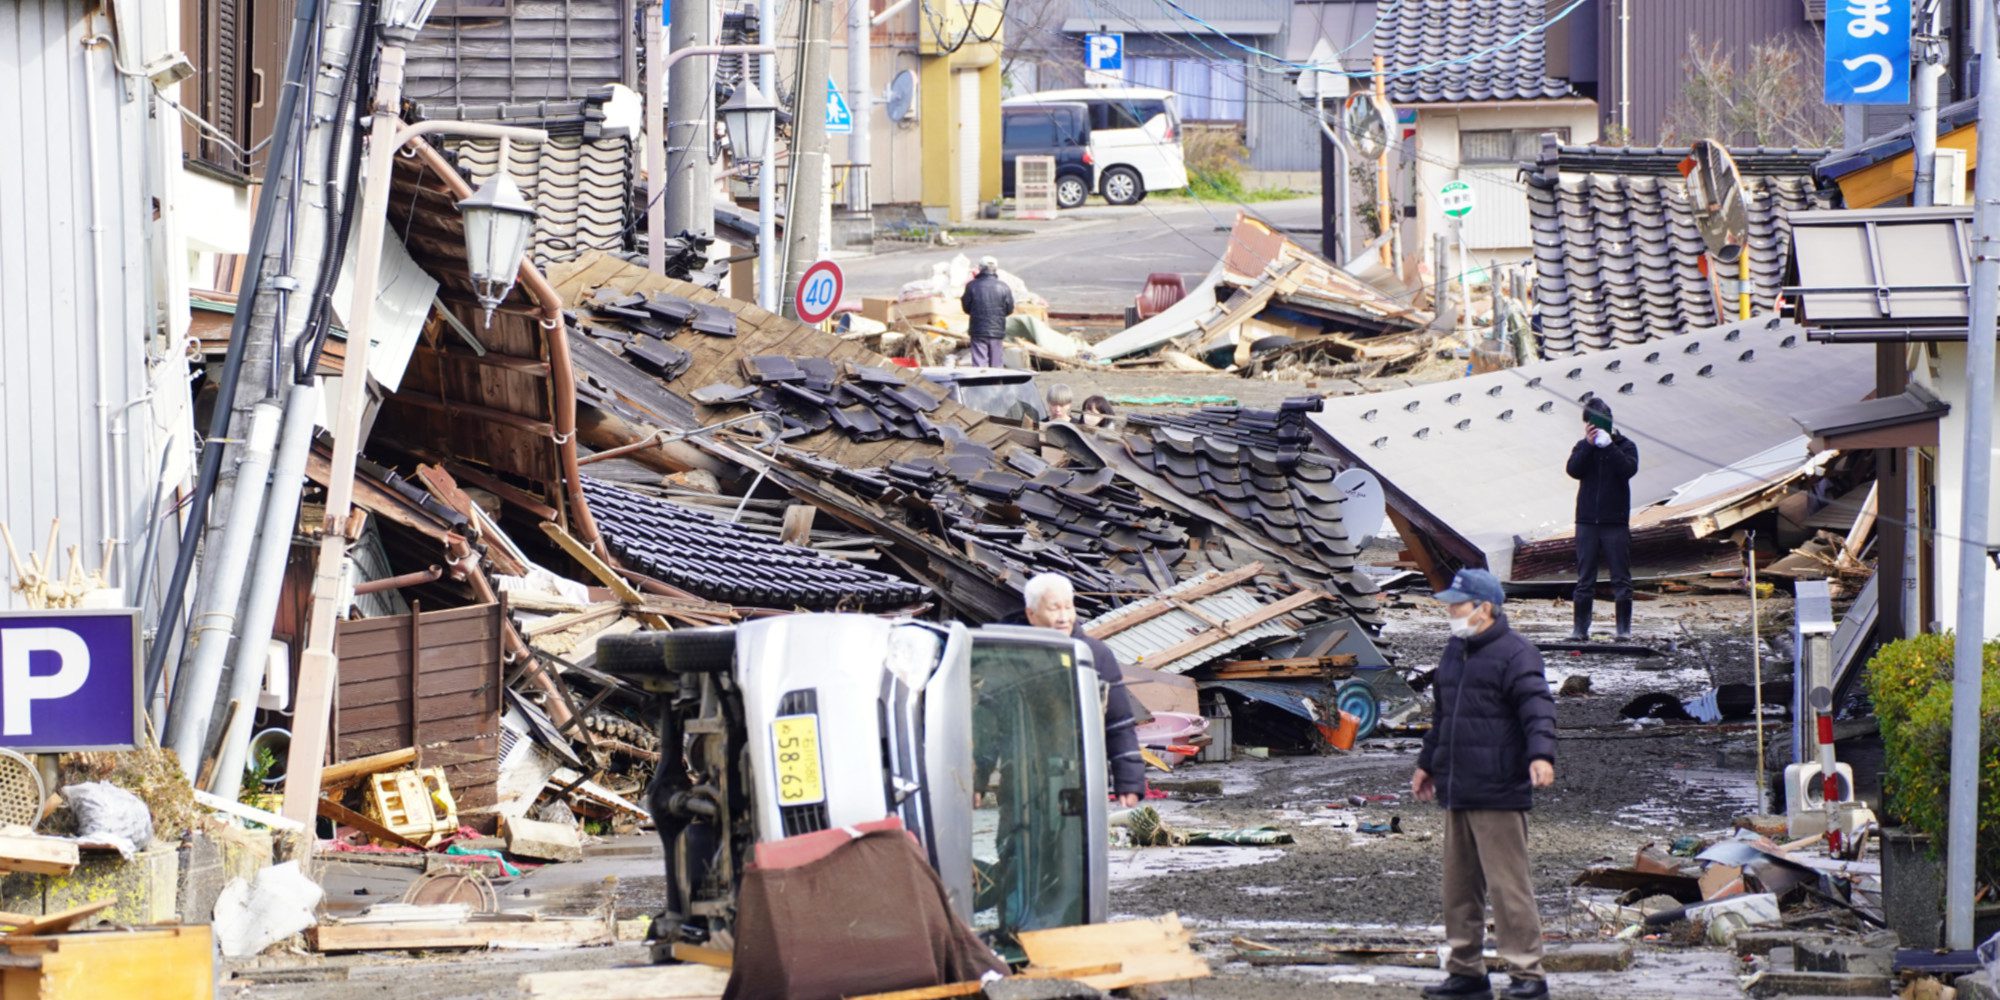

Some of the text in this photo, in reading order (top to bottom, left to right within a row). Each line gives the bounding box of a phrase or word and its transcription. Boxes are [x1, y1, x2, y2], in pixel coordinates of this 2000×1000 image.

[1091, 36, 1118, 69] P
[1842, 0, 1893, 93] まつ
[806, 278, 833, 306] 40
[1, 627, 91, 736] P
